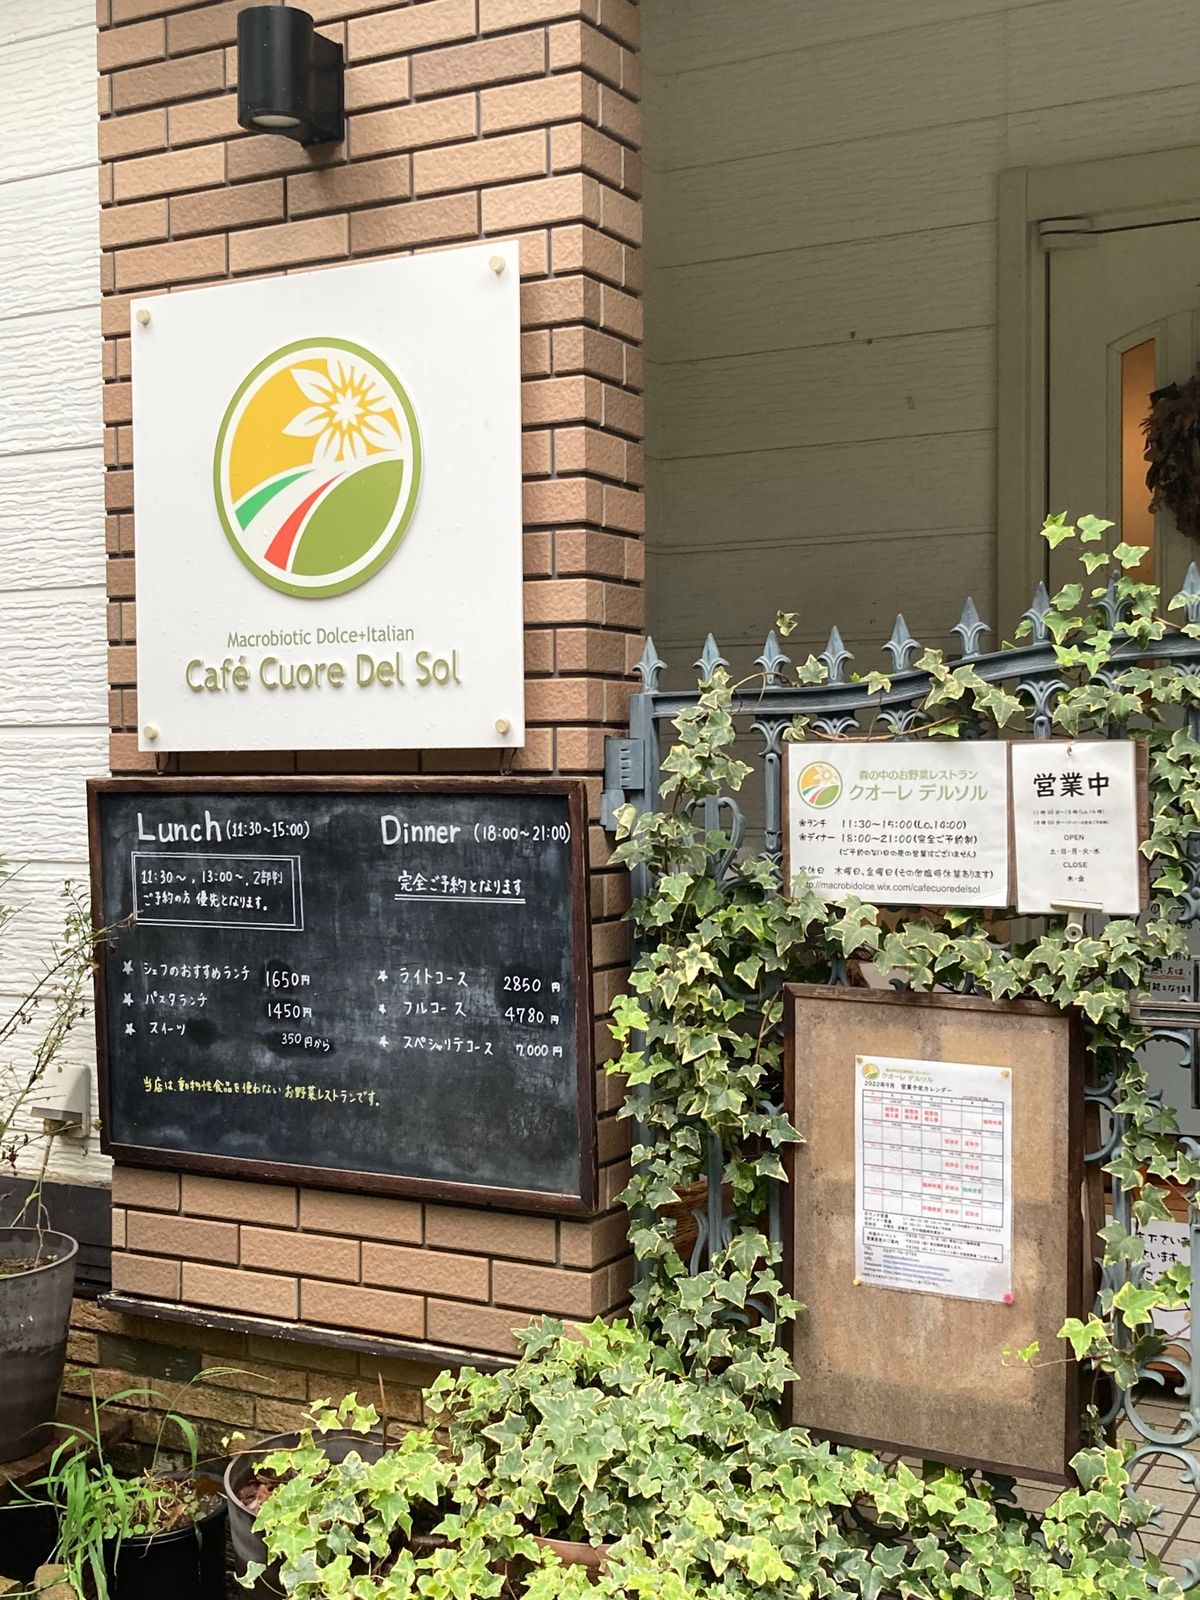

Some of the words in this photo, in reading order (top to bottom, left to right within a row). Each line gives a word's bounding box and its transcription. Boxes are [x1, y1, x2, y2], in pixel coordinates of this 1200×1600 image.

[227, 629, 312, 648] Macrobiotic
[316, 625, 415, 645] Dolce+Italian
[185, 655, 250, 693] Café
[259, 656, 347, 690] Cuore
[356, 651, 406, 687] Del
[415, 649, 463, 687] Sol
[849, 784, 913, 801] クオーレ
[920, 783, 989, 801] デルソル
[1033, 771, 1110, 798] 営業中
[137, 810, 222, 842] Lunch
[380, 814, 462, 845] Dinner
[397, 870, 522, 896] 完全ご予約となります
[805, 881, 981, 894] tp://macrobidolce.wix.com/cafecuoredelsol
